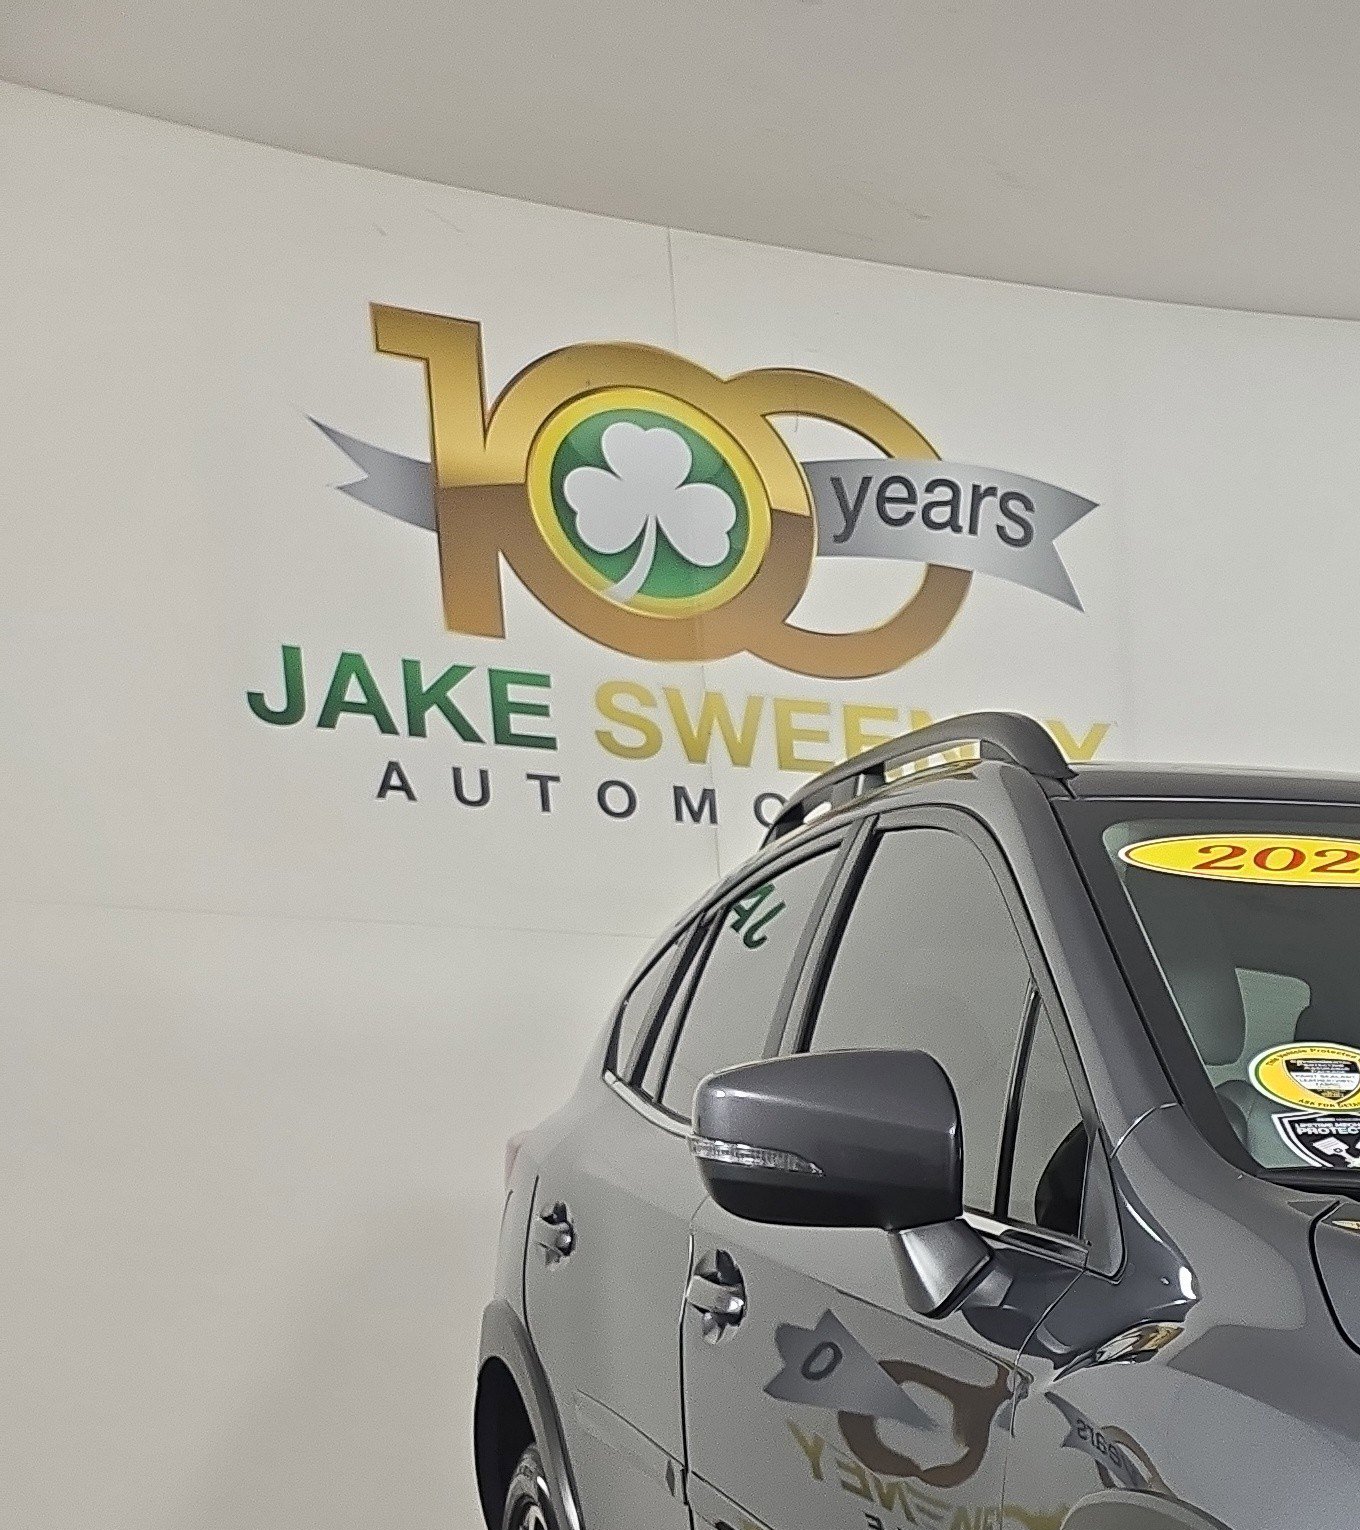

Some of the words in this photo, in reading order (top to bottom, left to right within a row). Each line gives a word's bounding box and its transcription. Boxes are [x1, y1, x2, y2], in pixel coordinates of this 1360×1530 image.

[369, 301, 974, 680] 100
[829, 466, 1037, 548] years
[246, 644, 559, 752] JAKE
[594, 679, 1112, 774] SWEEY
[376, 760, 789, 828] AUTOMO
